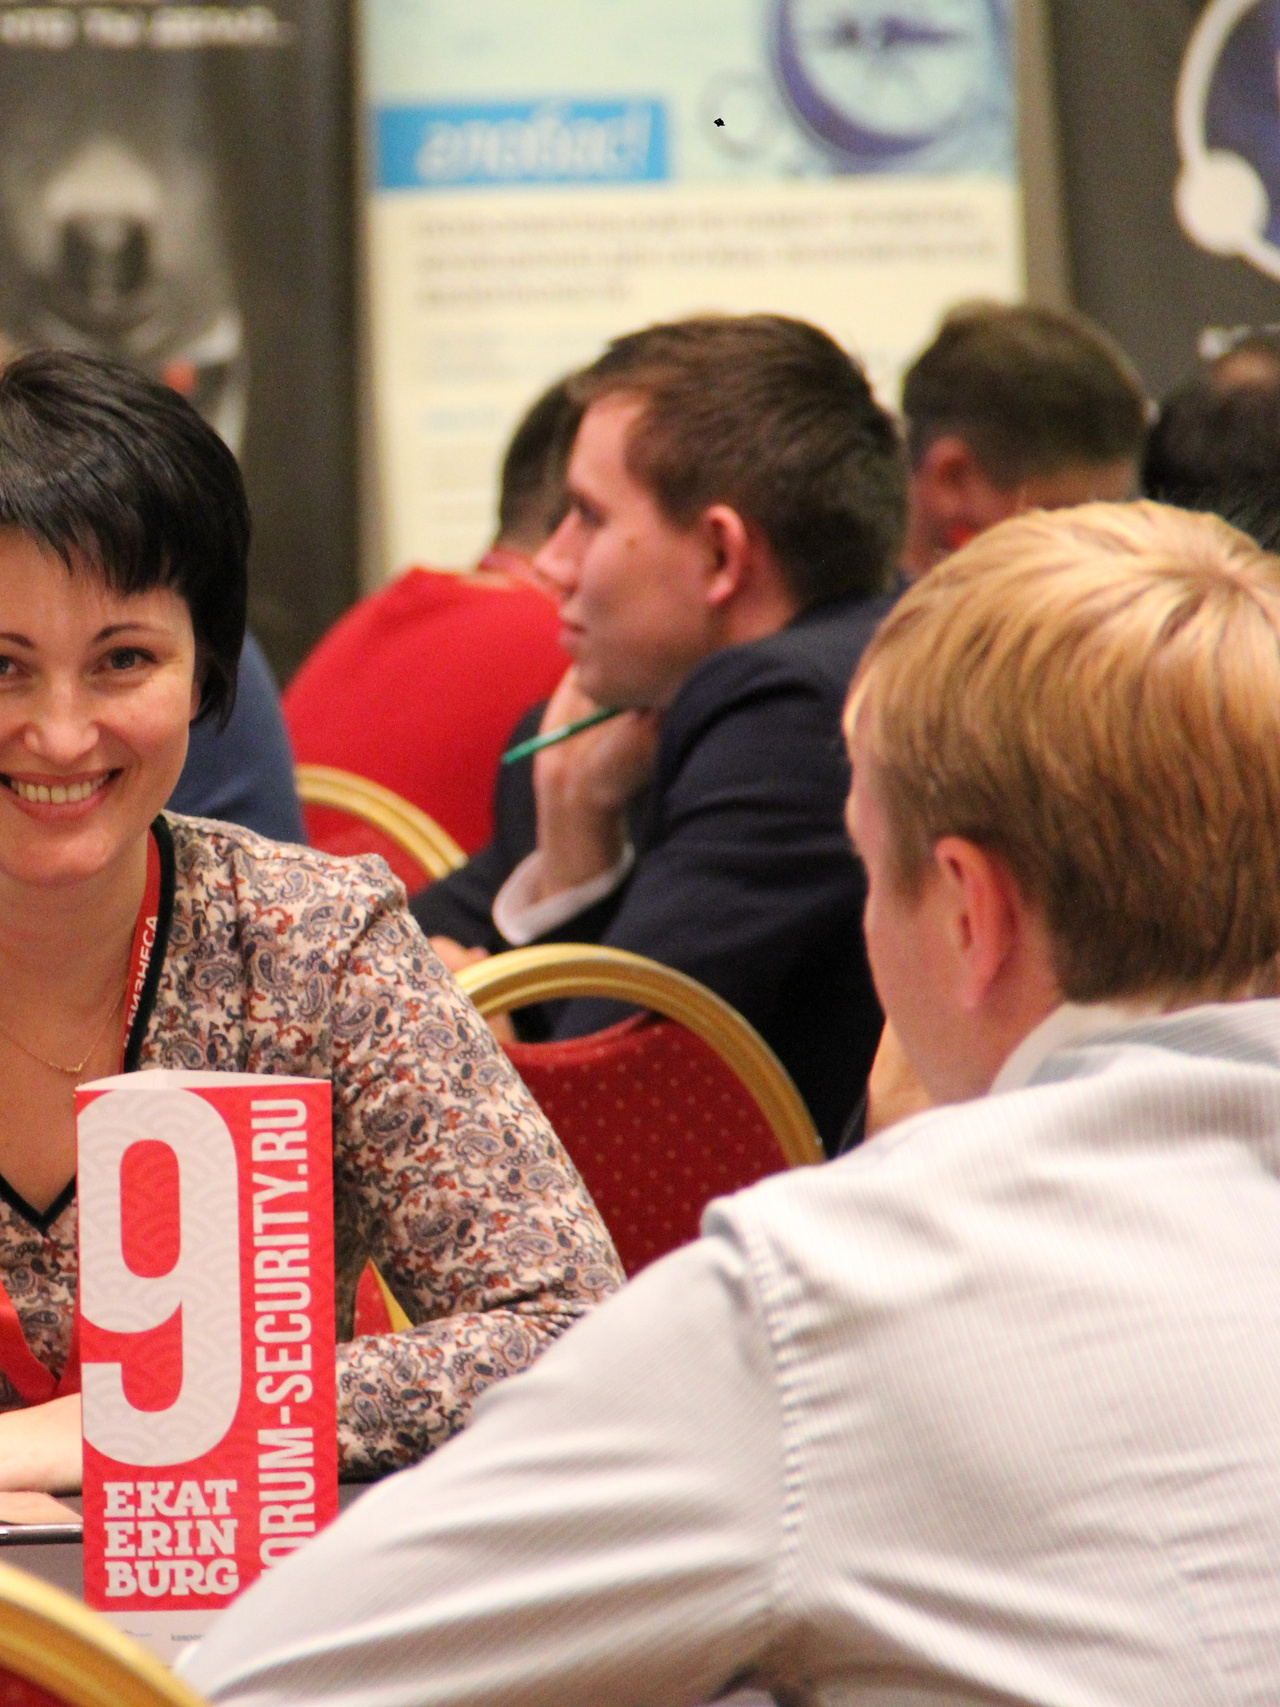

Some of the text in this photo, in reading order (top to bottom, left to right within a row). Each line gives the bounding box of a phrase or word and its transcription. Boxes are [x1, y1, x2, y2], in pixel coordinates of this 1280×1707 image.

[77, 1089, 241, 1467] 9
[251, 1099, 317, 1577] ORUM-SECURITY.RU
[103, 1479, 238, 1517] EKAT
[104, 1519, 238, 1557] ERIN
[104, 1558, 240, 1597] BURG
